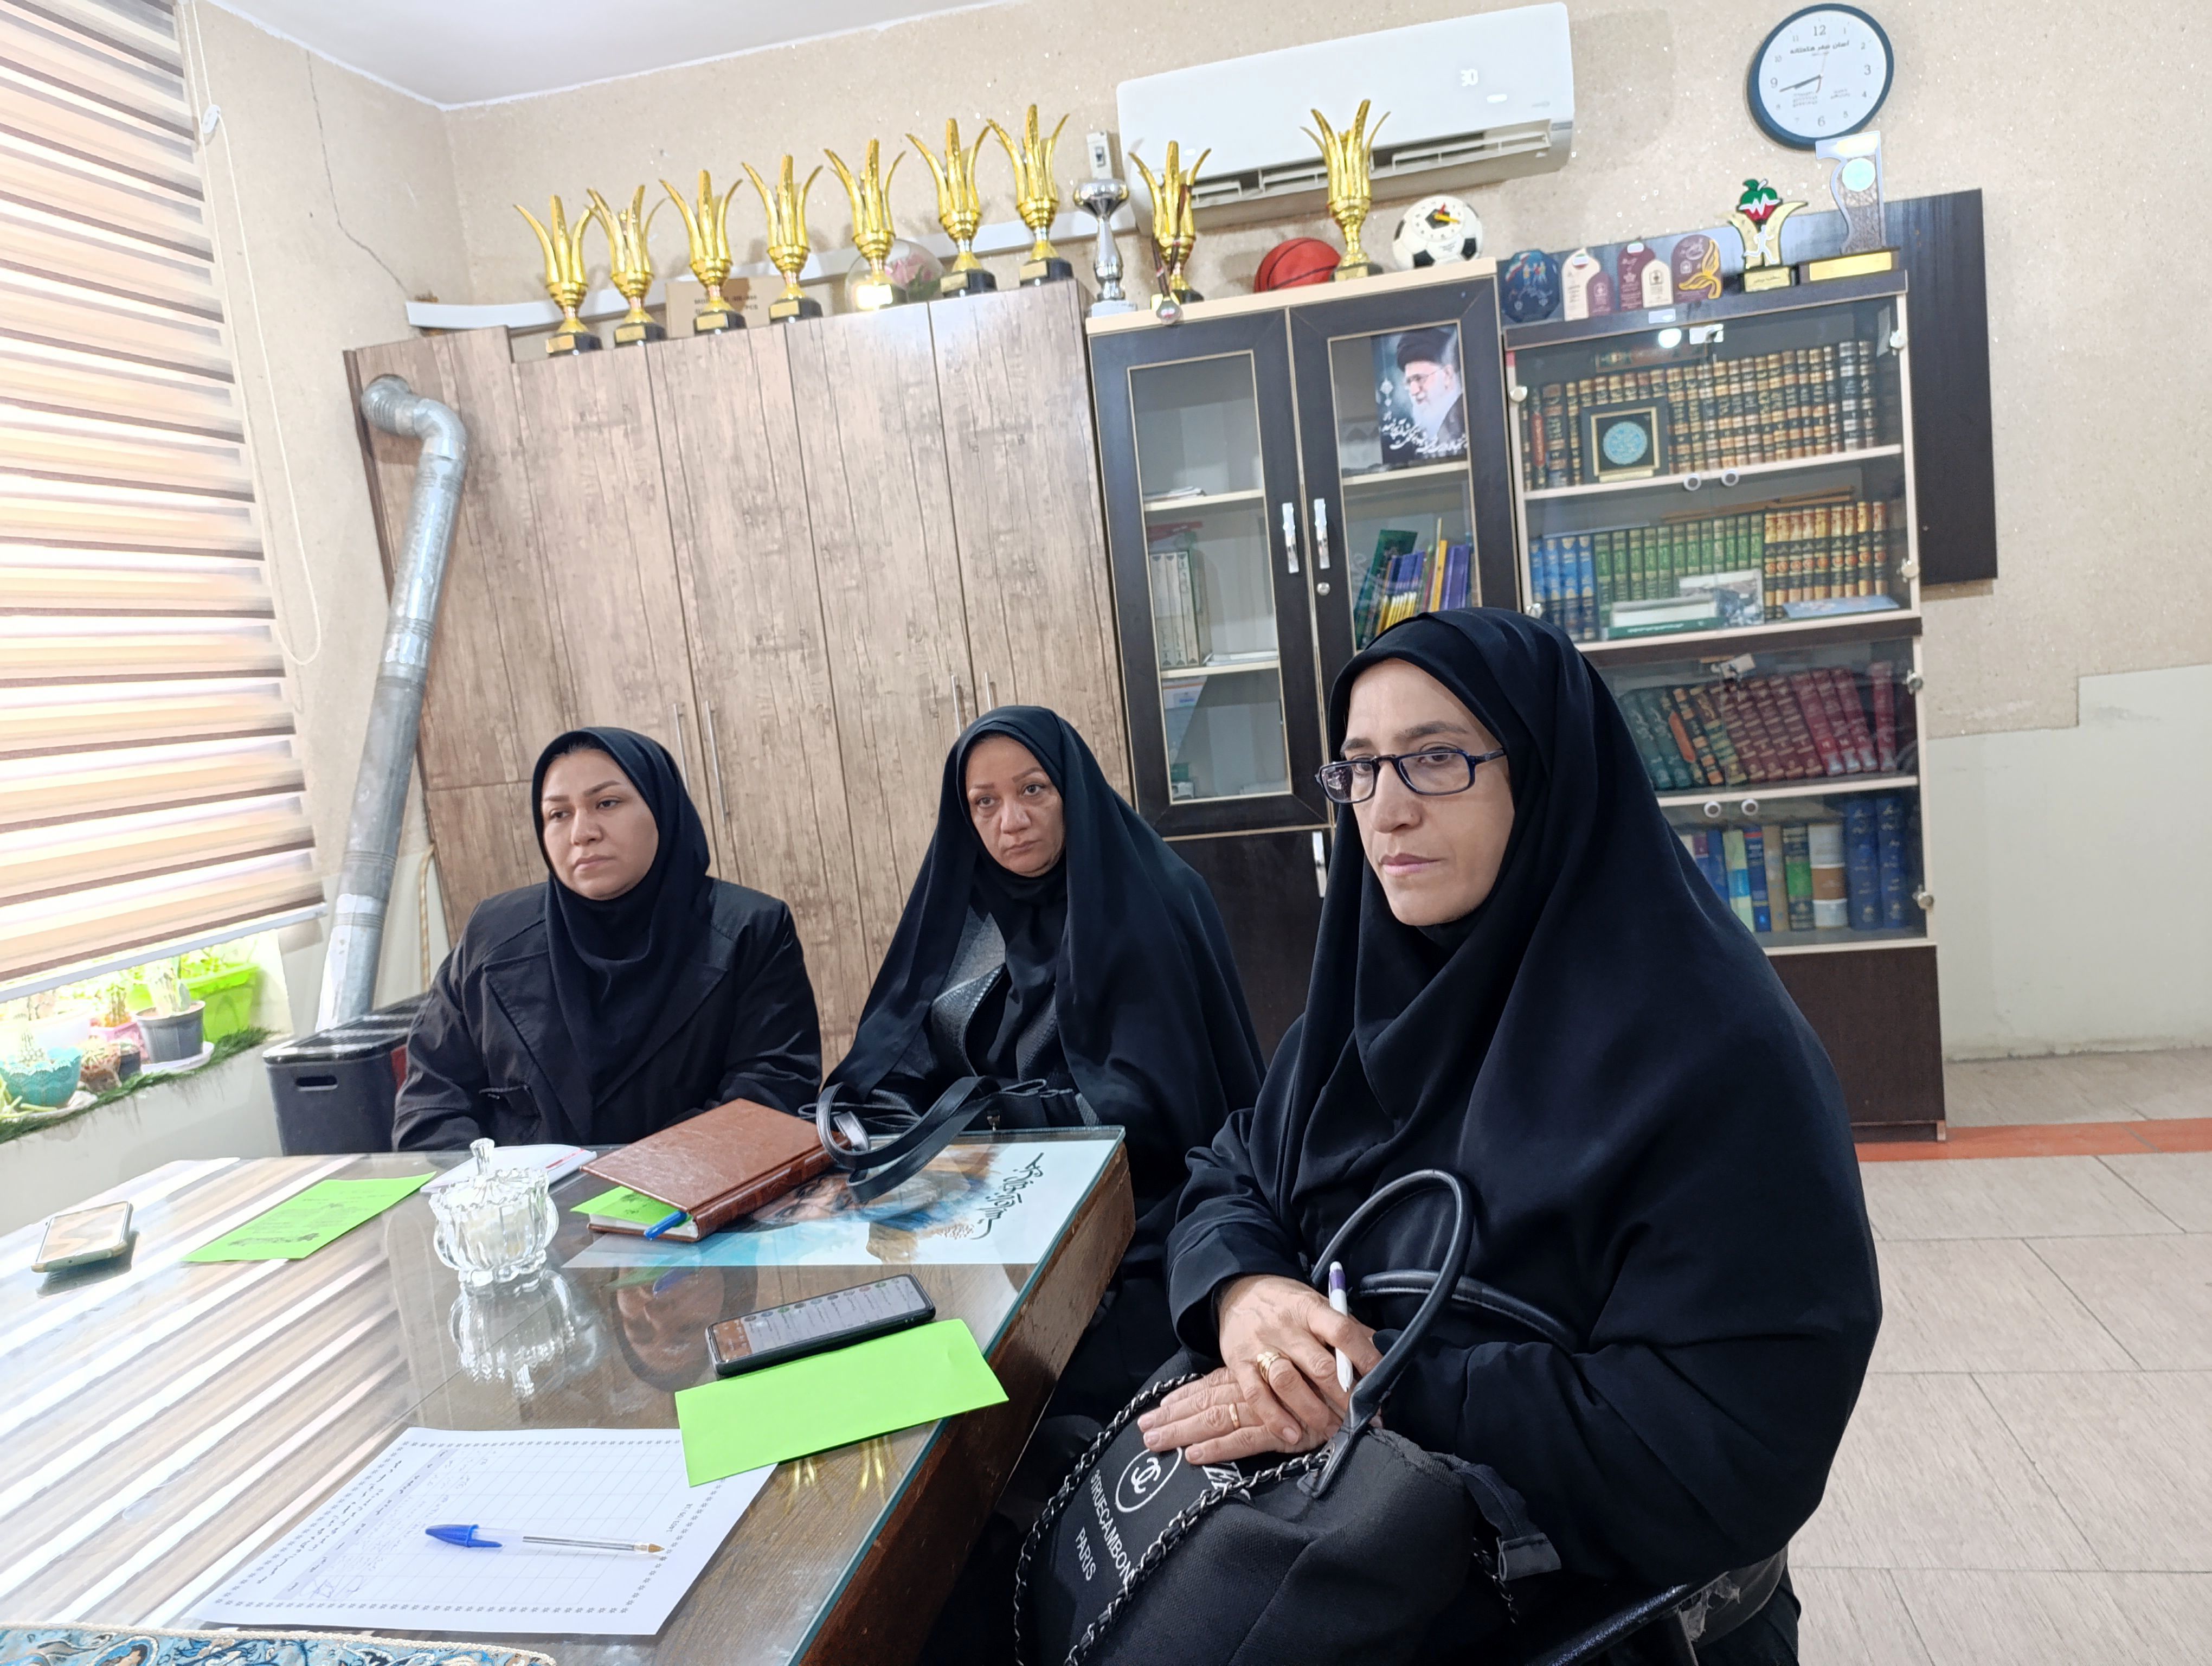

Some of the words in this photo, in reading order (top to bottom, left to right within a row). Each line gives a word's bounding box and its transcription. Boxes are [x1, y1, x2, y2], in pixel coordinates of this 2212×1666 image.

[1813, 25, 1826, 36] 12
[1861, 42, 1866, 50] 2
[1774, 55, 1782, 63] 10
[1864, 65, 1871, 75] 3
[1770, 78, 1778, 88] 9
[1817, 117, 1825, 126] 6
[666, 1503, 693, 1533] 1403/09/18
[1076, 1526, 1096, 1581] PARIS
